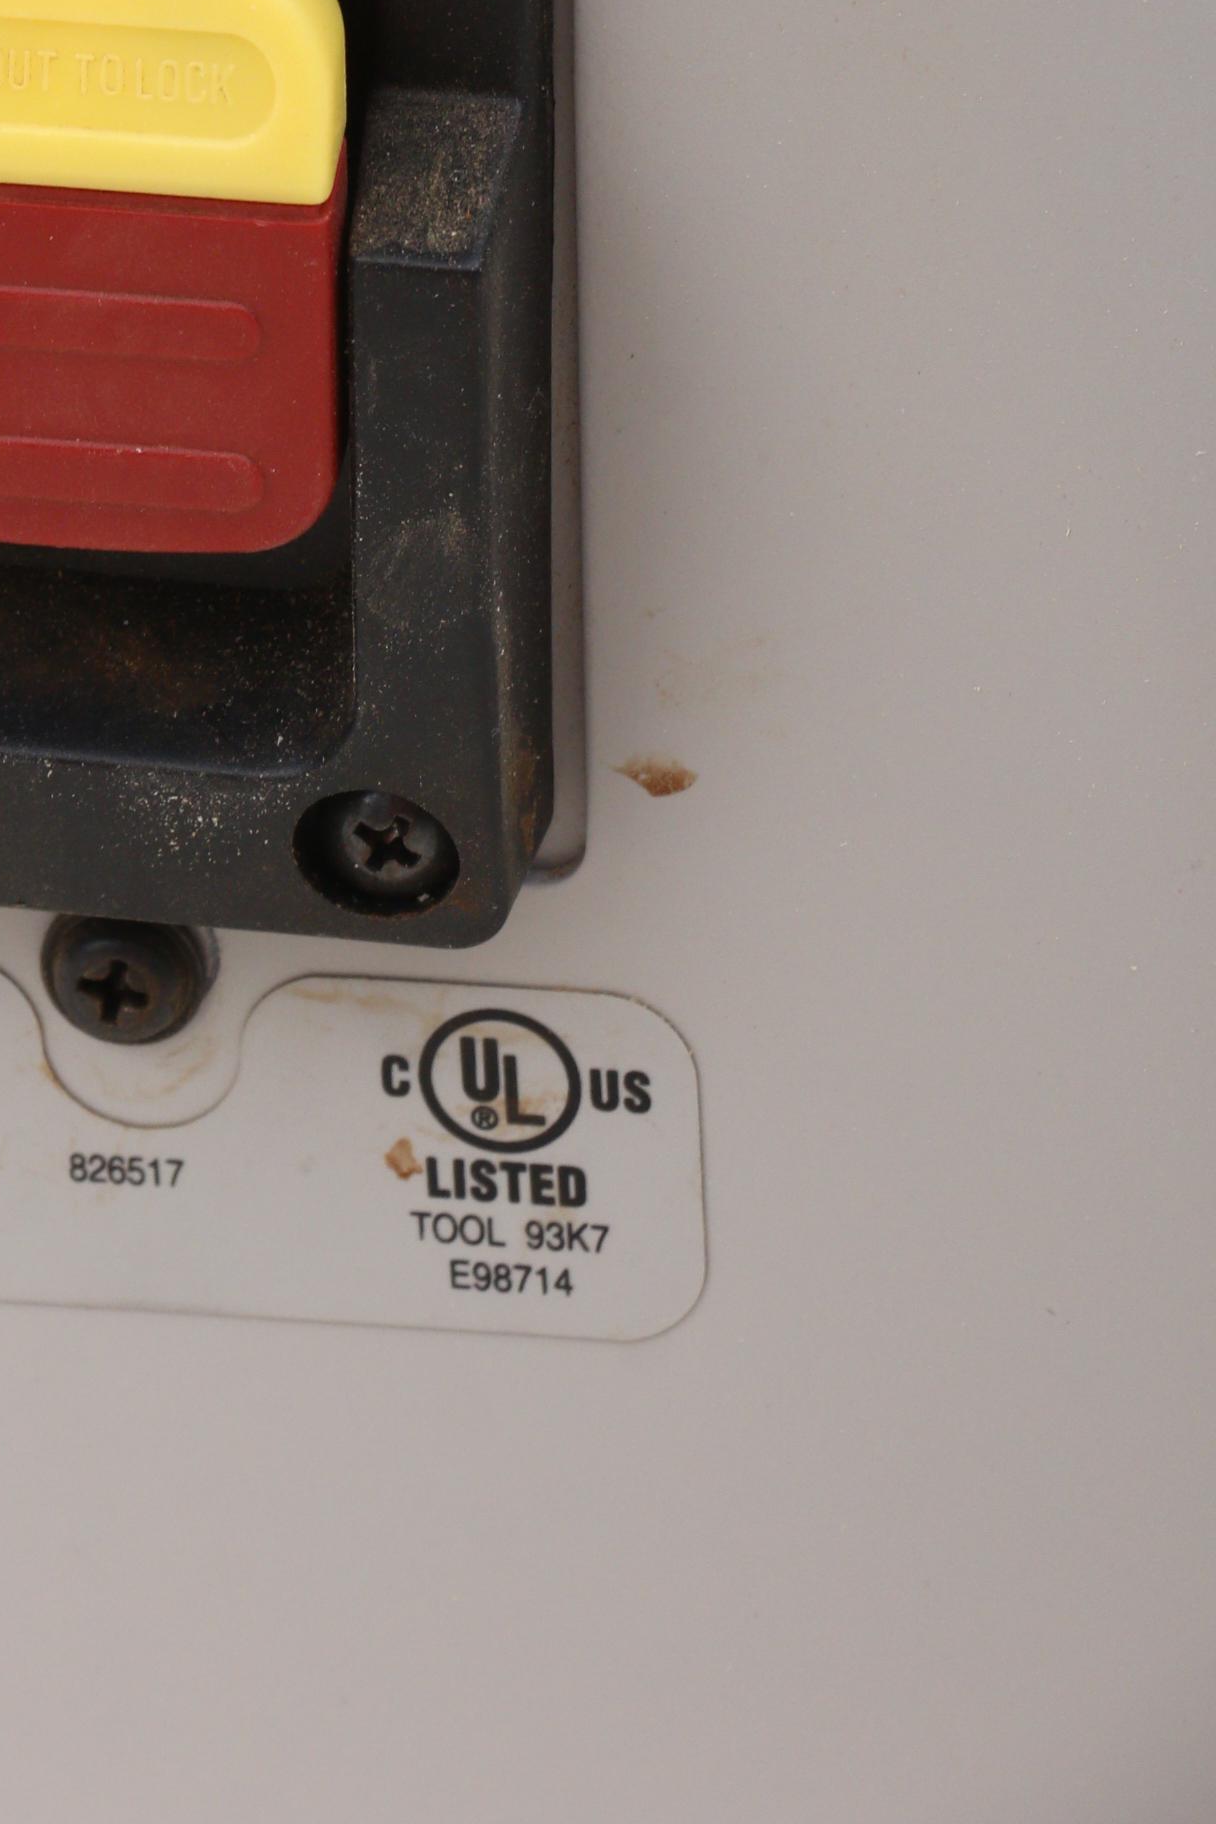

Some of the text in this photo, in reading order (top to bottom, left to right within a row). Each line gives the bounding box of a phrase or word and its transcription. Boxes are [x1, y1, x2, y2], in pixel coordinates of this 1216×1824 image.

[76, 53, 126, 97] TO
[134, 57, 236, 106] LOCK
[589, 1068, 653, 1114] US
[69, 1153, 184, 1188] 826517
[426, 1156, 588, 1208] LISTED
[410, 1211, 610, 1254] TOOL 93K7
[449, 1259, 573, 1297] E98714
